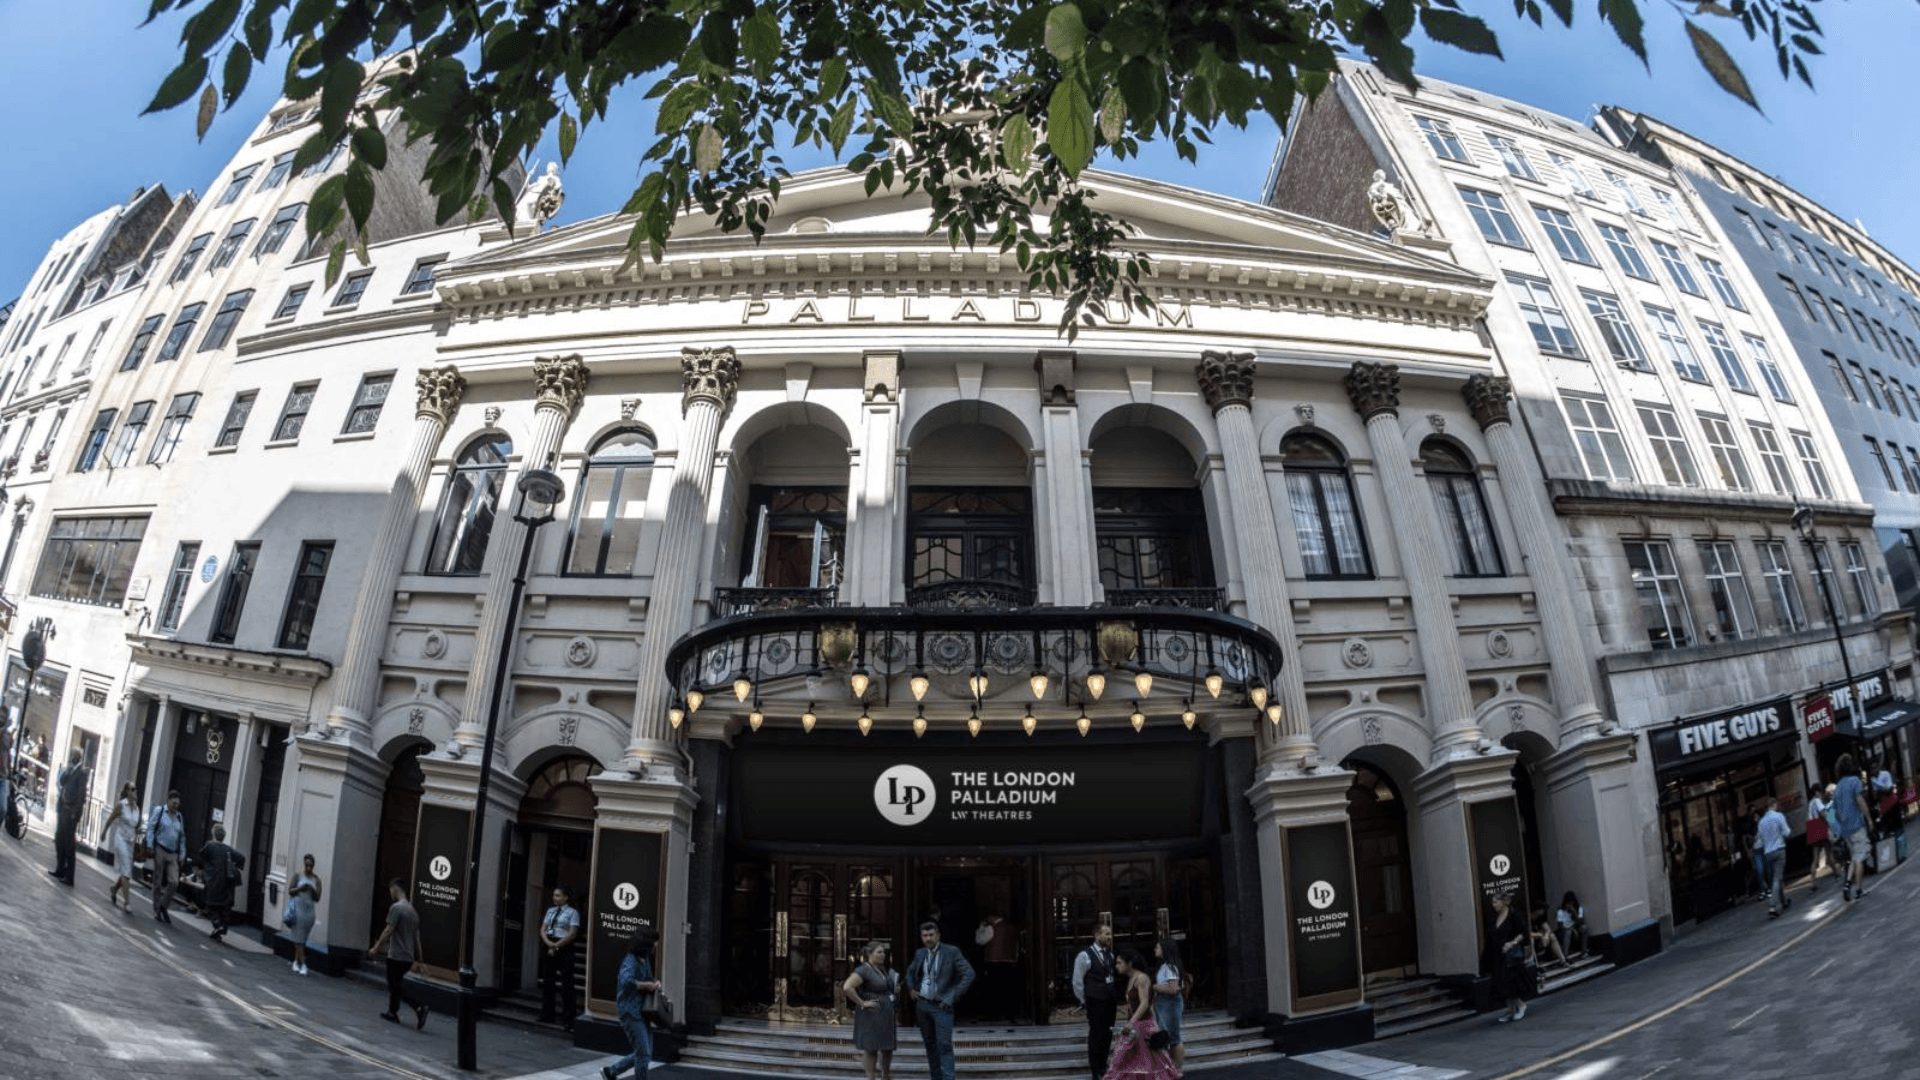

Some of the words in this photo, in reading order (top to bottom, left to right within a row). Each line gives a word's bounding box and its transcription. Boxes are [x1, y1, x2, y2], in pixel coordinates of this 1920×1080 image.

[742, 297, 1193, 328] PALLADUM
[1807, 707, 1827, 723] FIVE
[1679, 719, 1729, 755] FIVE
[1729, 707, 1779, 741] GUYS
[1807, 717, 1831, 734] GUYS
[951, 772, 988, 786] THE
[993, 772, 1076, 786] LONDON
[951, 790, 1057, 804] PALLADIUM
[973, 811, 1032, 820] THEATRES
[419, 881, 430, 889] THE
[431, 884, 459, 894] LONDON
[420, 888, 456, 900] PALLADIUM
[600, 912, 614, 921] THE
[616, 914, 650, 926] LONDON
[1297, 916, 1313, 924] THE
[1315, 911, 1348, 922] LONDON
[1301, 920, 1346, 933] PALLADIUM
